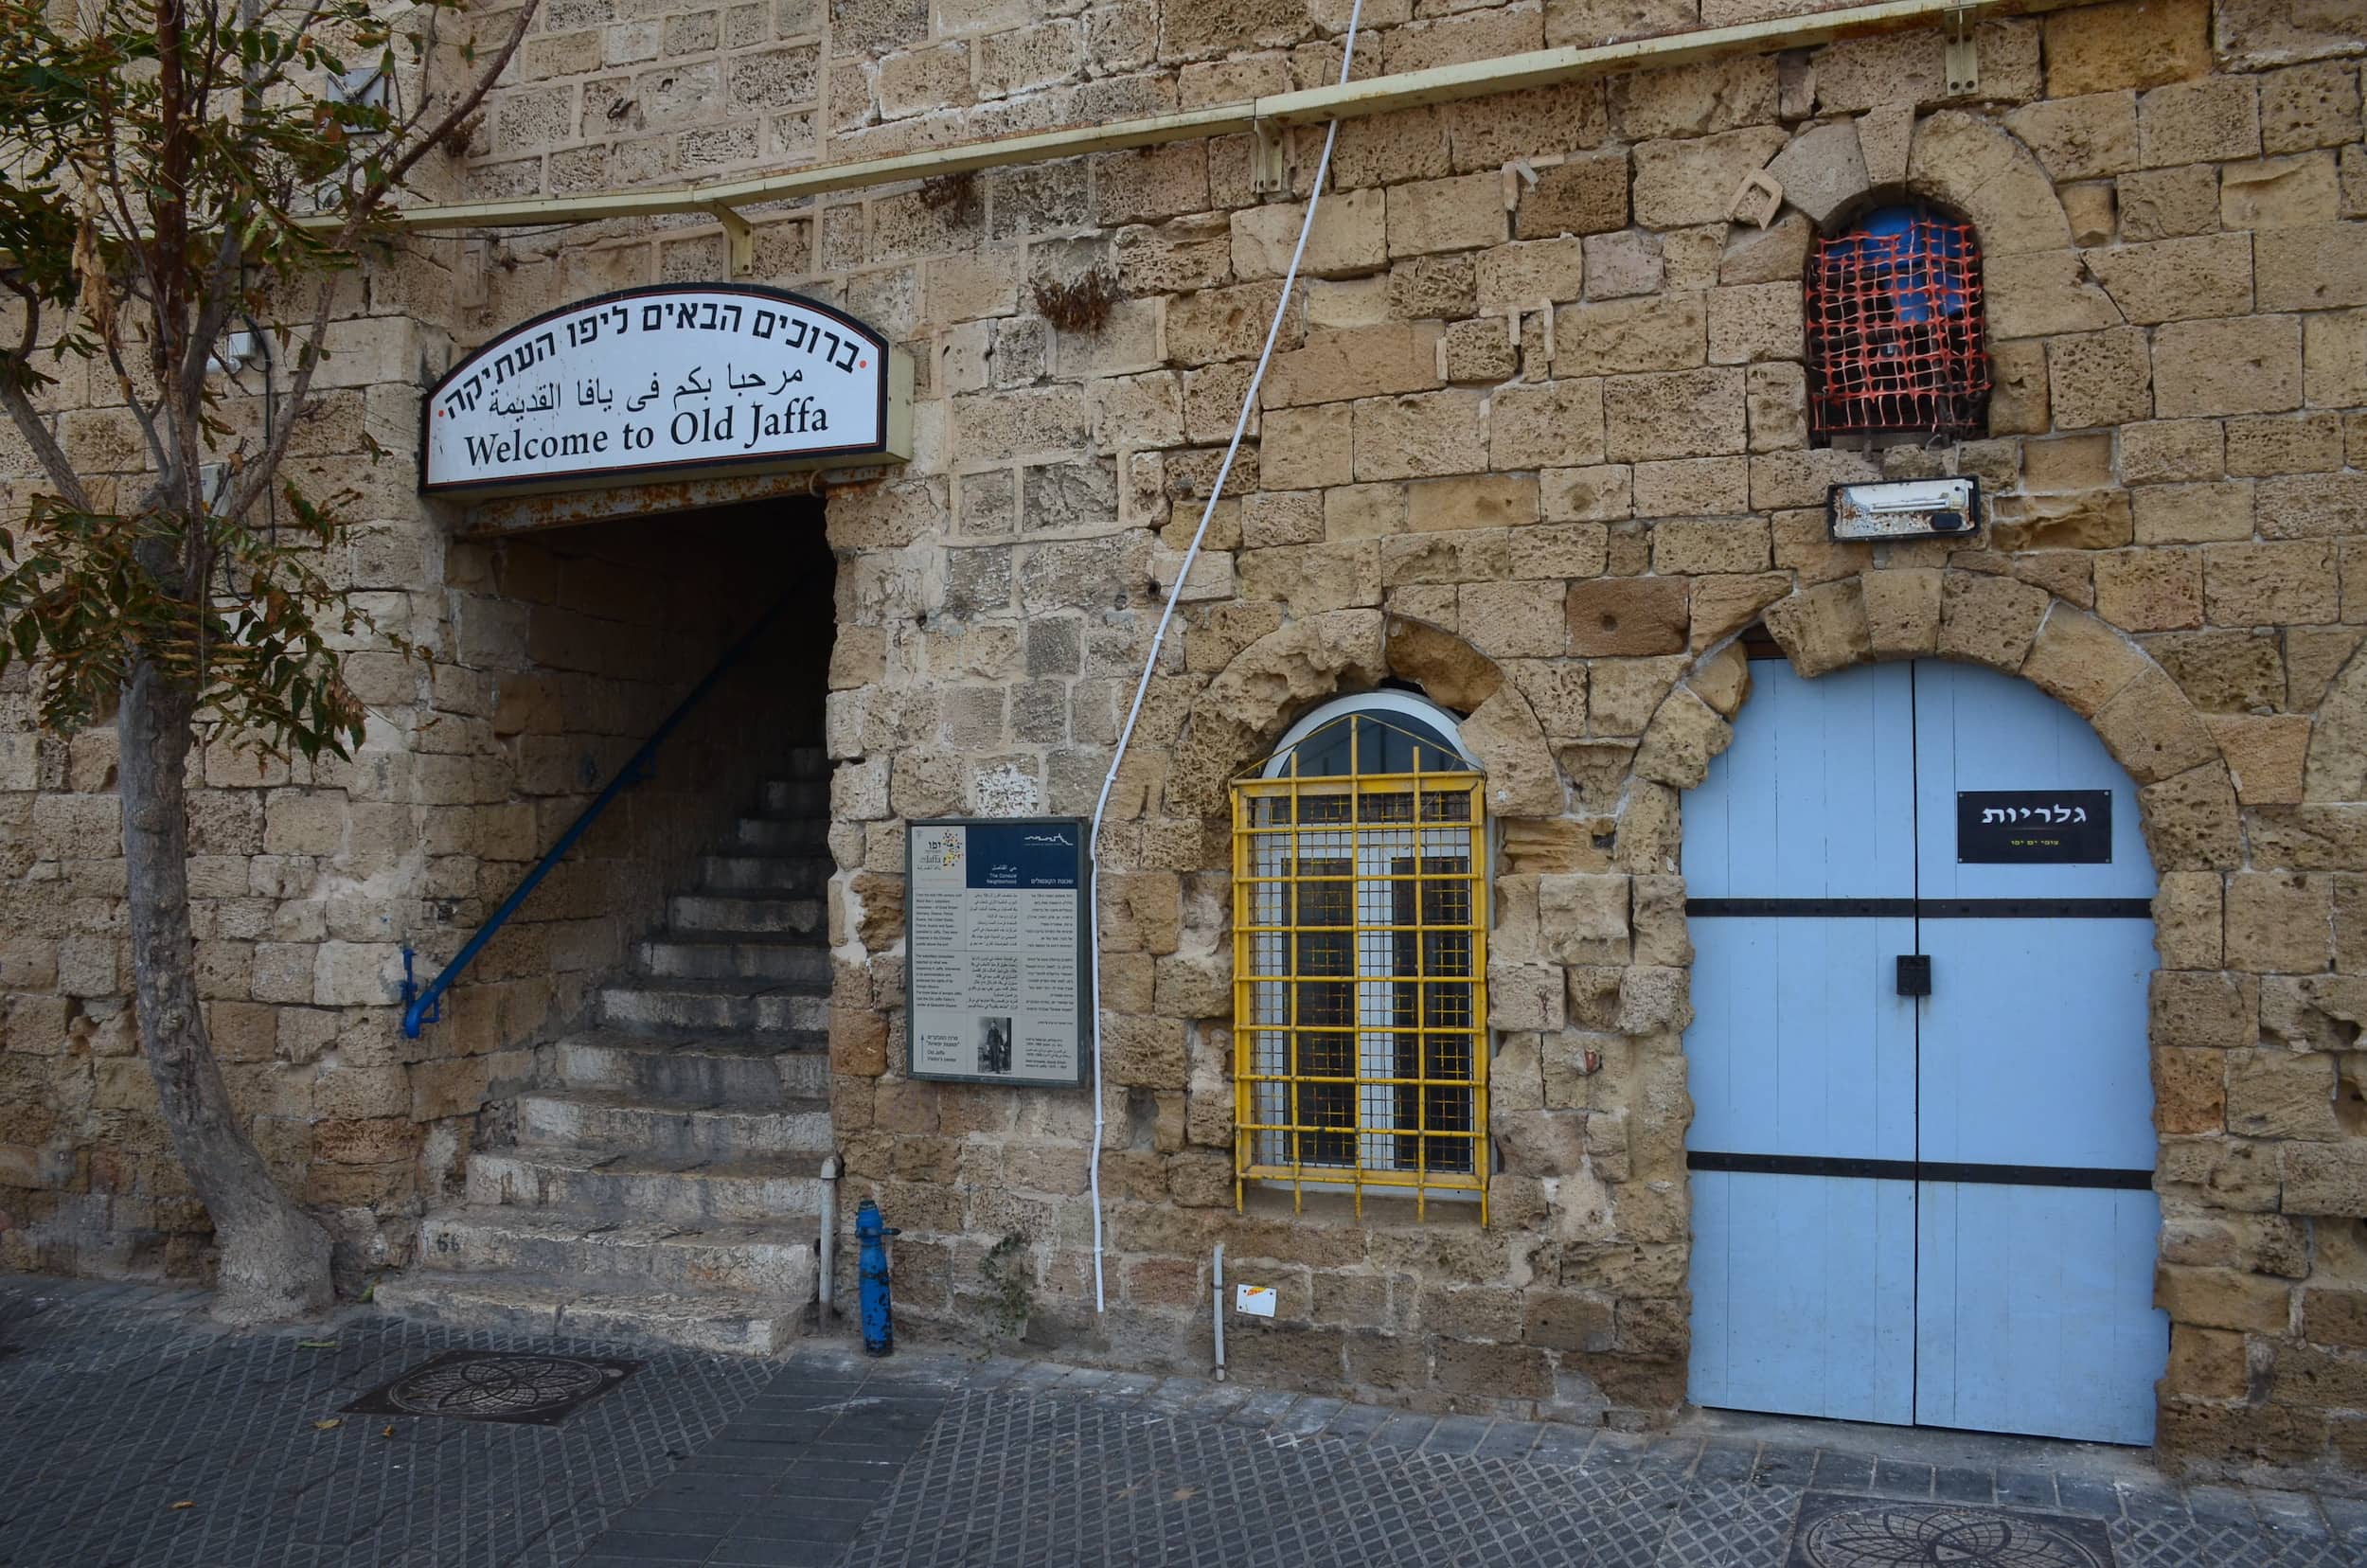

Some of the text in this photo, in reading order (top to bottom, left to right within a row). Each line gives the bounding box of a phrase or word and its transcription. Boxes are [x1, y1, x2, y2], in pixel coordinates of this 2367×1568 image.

[444, 302, 861, 419] ברוכים הבאים ליפו העתיקה
[727, 362, 804, 398] مرحبا
[489, 382, 561, 422] القديمة
[577, 377, 614, 413] يافا
[673, 365, 712, 411] بكم
[464, 396, 829, 467] Welcome to Old Jaffa
[1982, 804, 2088, 824] גלריות
